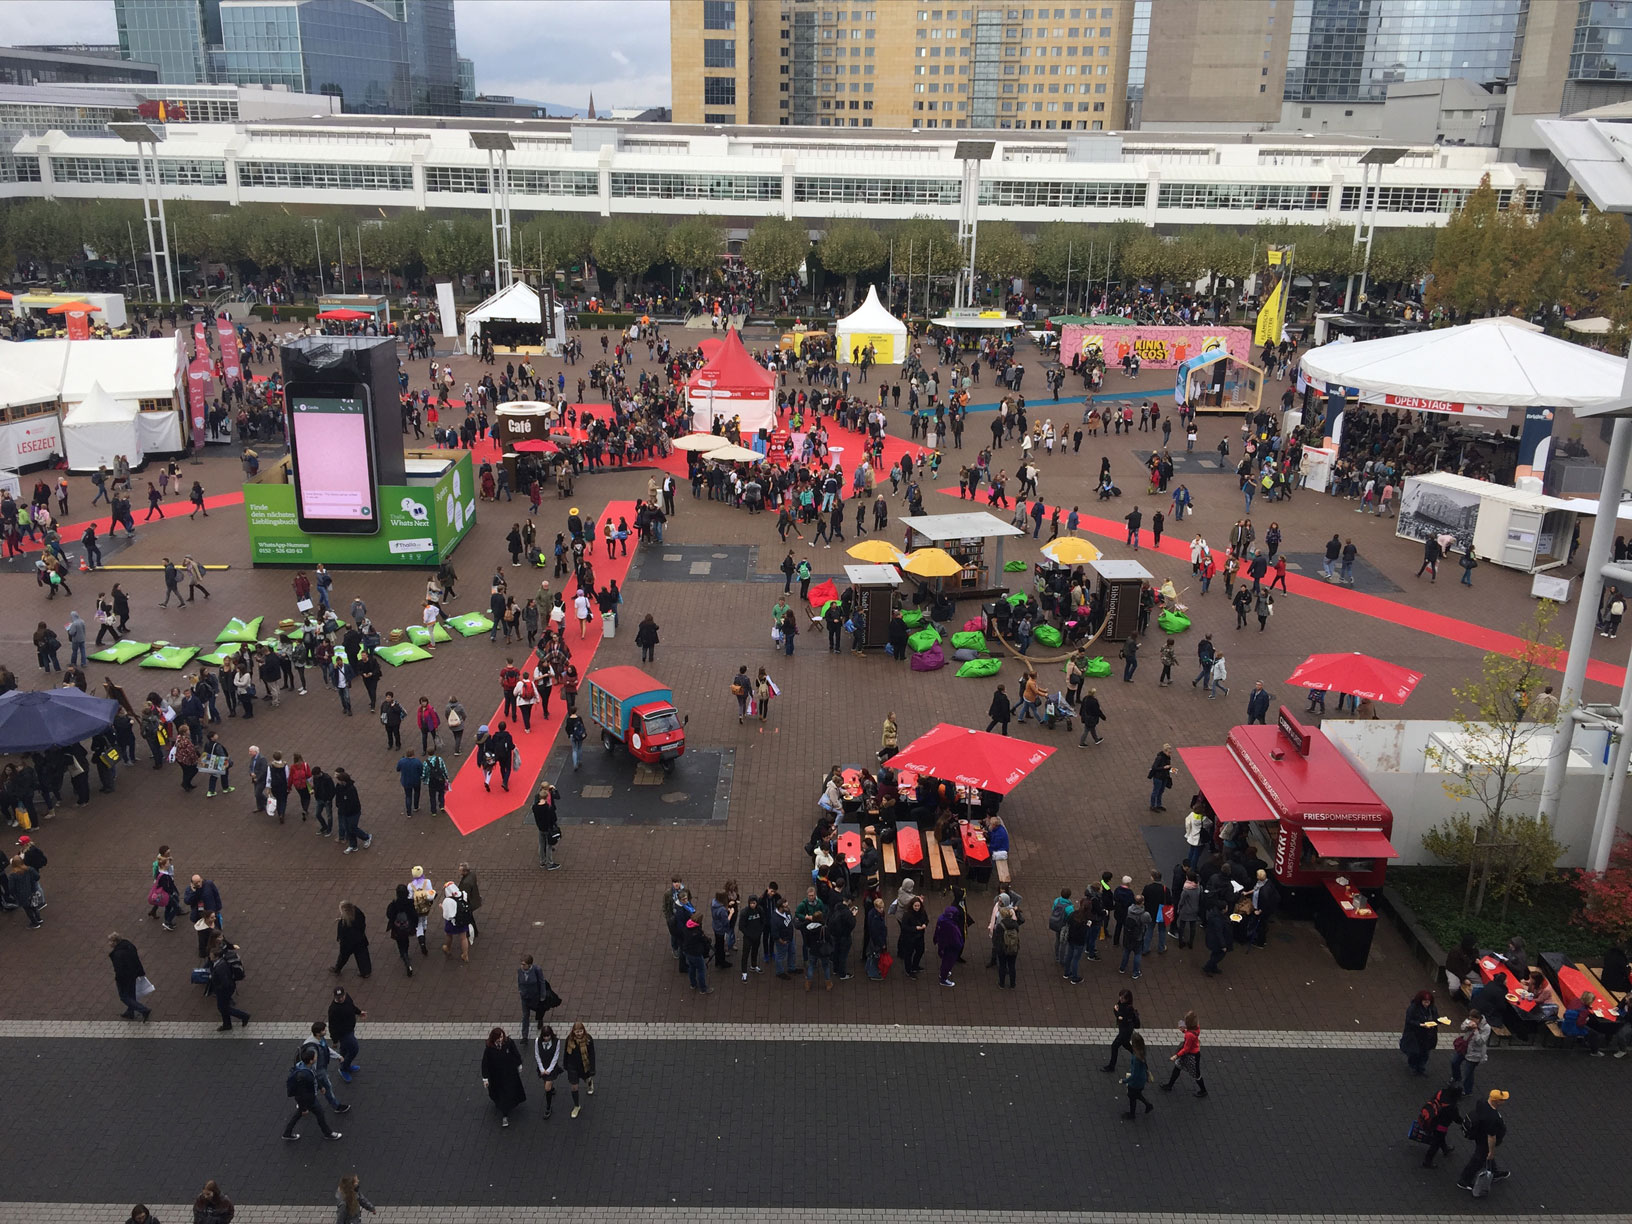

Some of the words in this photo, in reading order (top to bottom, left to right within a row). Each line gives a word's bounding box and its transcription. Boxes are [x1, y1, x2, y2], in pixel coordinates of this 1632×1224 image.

[1134, 340, 1168, 351] KINKY
[1141, 349, 1170, 360] COSY
[1394, 396, 1418, 407] OPEN
[1421, 399, 1452, 411] STAGE
[508, 419, 531, 433] Café
[17, 436, 56, 454] LESEZELT
[391, 519, 413, 527] Whats
[1274, 824, 1288, 875] CURRY
[1286, 832, 1298, 878] WURST/SAUSAGE
